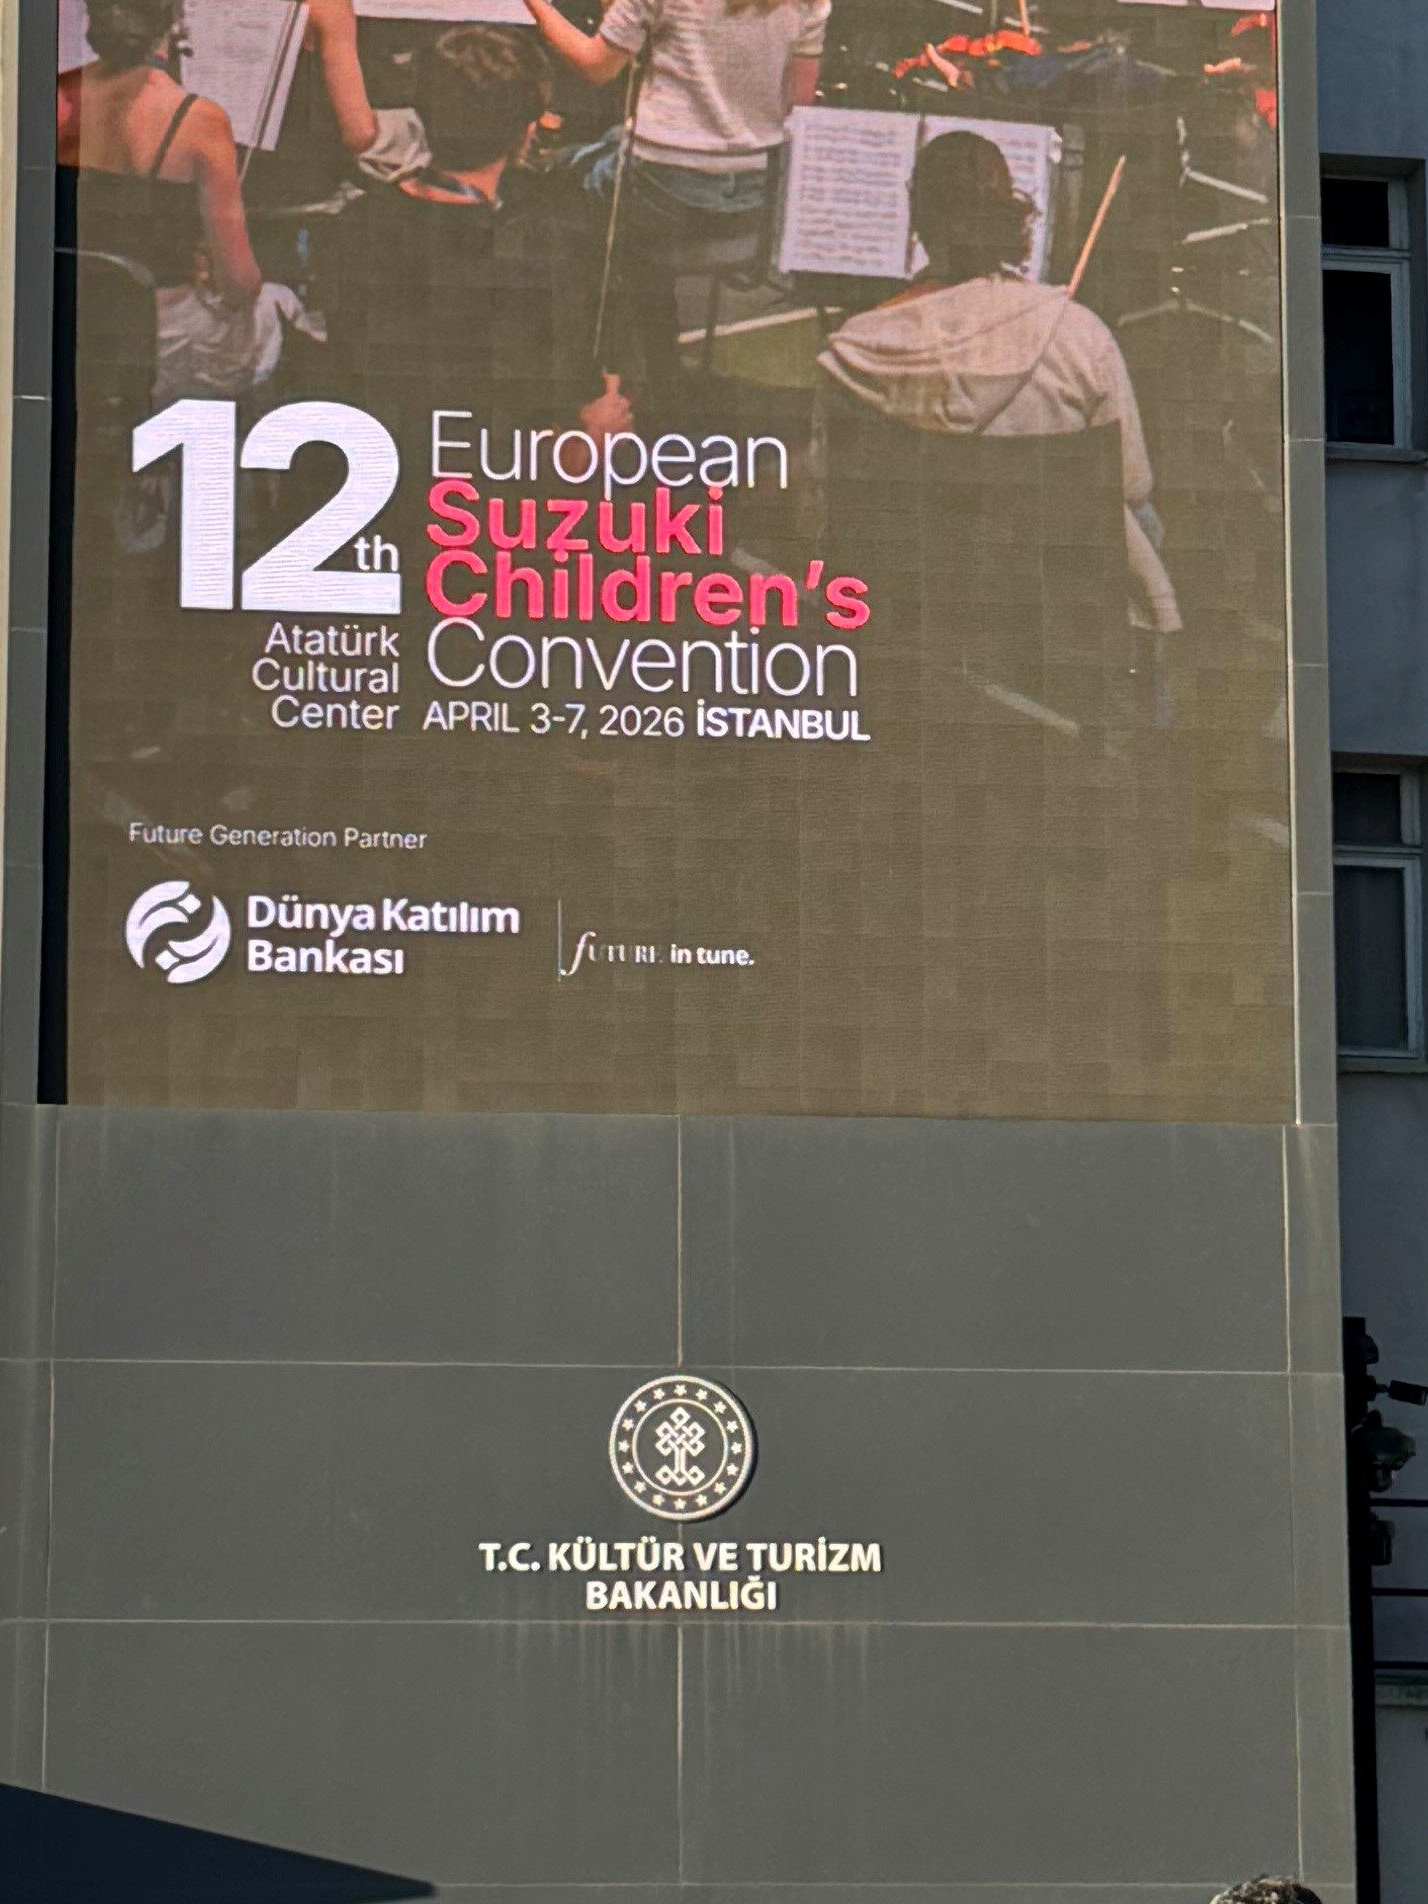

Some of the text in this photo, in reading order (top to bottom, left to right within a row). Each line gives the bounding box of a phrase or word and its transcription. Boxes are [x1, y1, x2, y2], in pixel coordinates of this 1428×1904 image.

[431, 410, 788, 501] European
[426, 479, 724, 556] Suzuki
[425, 550, 870, 629] Children's
[264, 622, 400, 658] Atatürk
[427, 616, 857, 697] Convention
[252, 657, 400, 694] Cultural
[271, 694, 400, 730] Center
[422, 699, 870, 742] APRIL 3-7, 2026 İSTANBUL
[129, 823, 427, 850] Future Generation Partner
[248, 895, 520, 937] Dünya Katılım
[248, 939, 404, 975] Bankası
[671, 943, 691, 964] in
[696, 947, 755, 965] tune.
[479, 1536, 882, 1572] T.C. KÜLTÜR VE TURİZM
[586, 1576, 777, 1611] BAKANLIĞI
